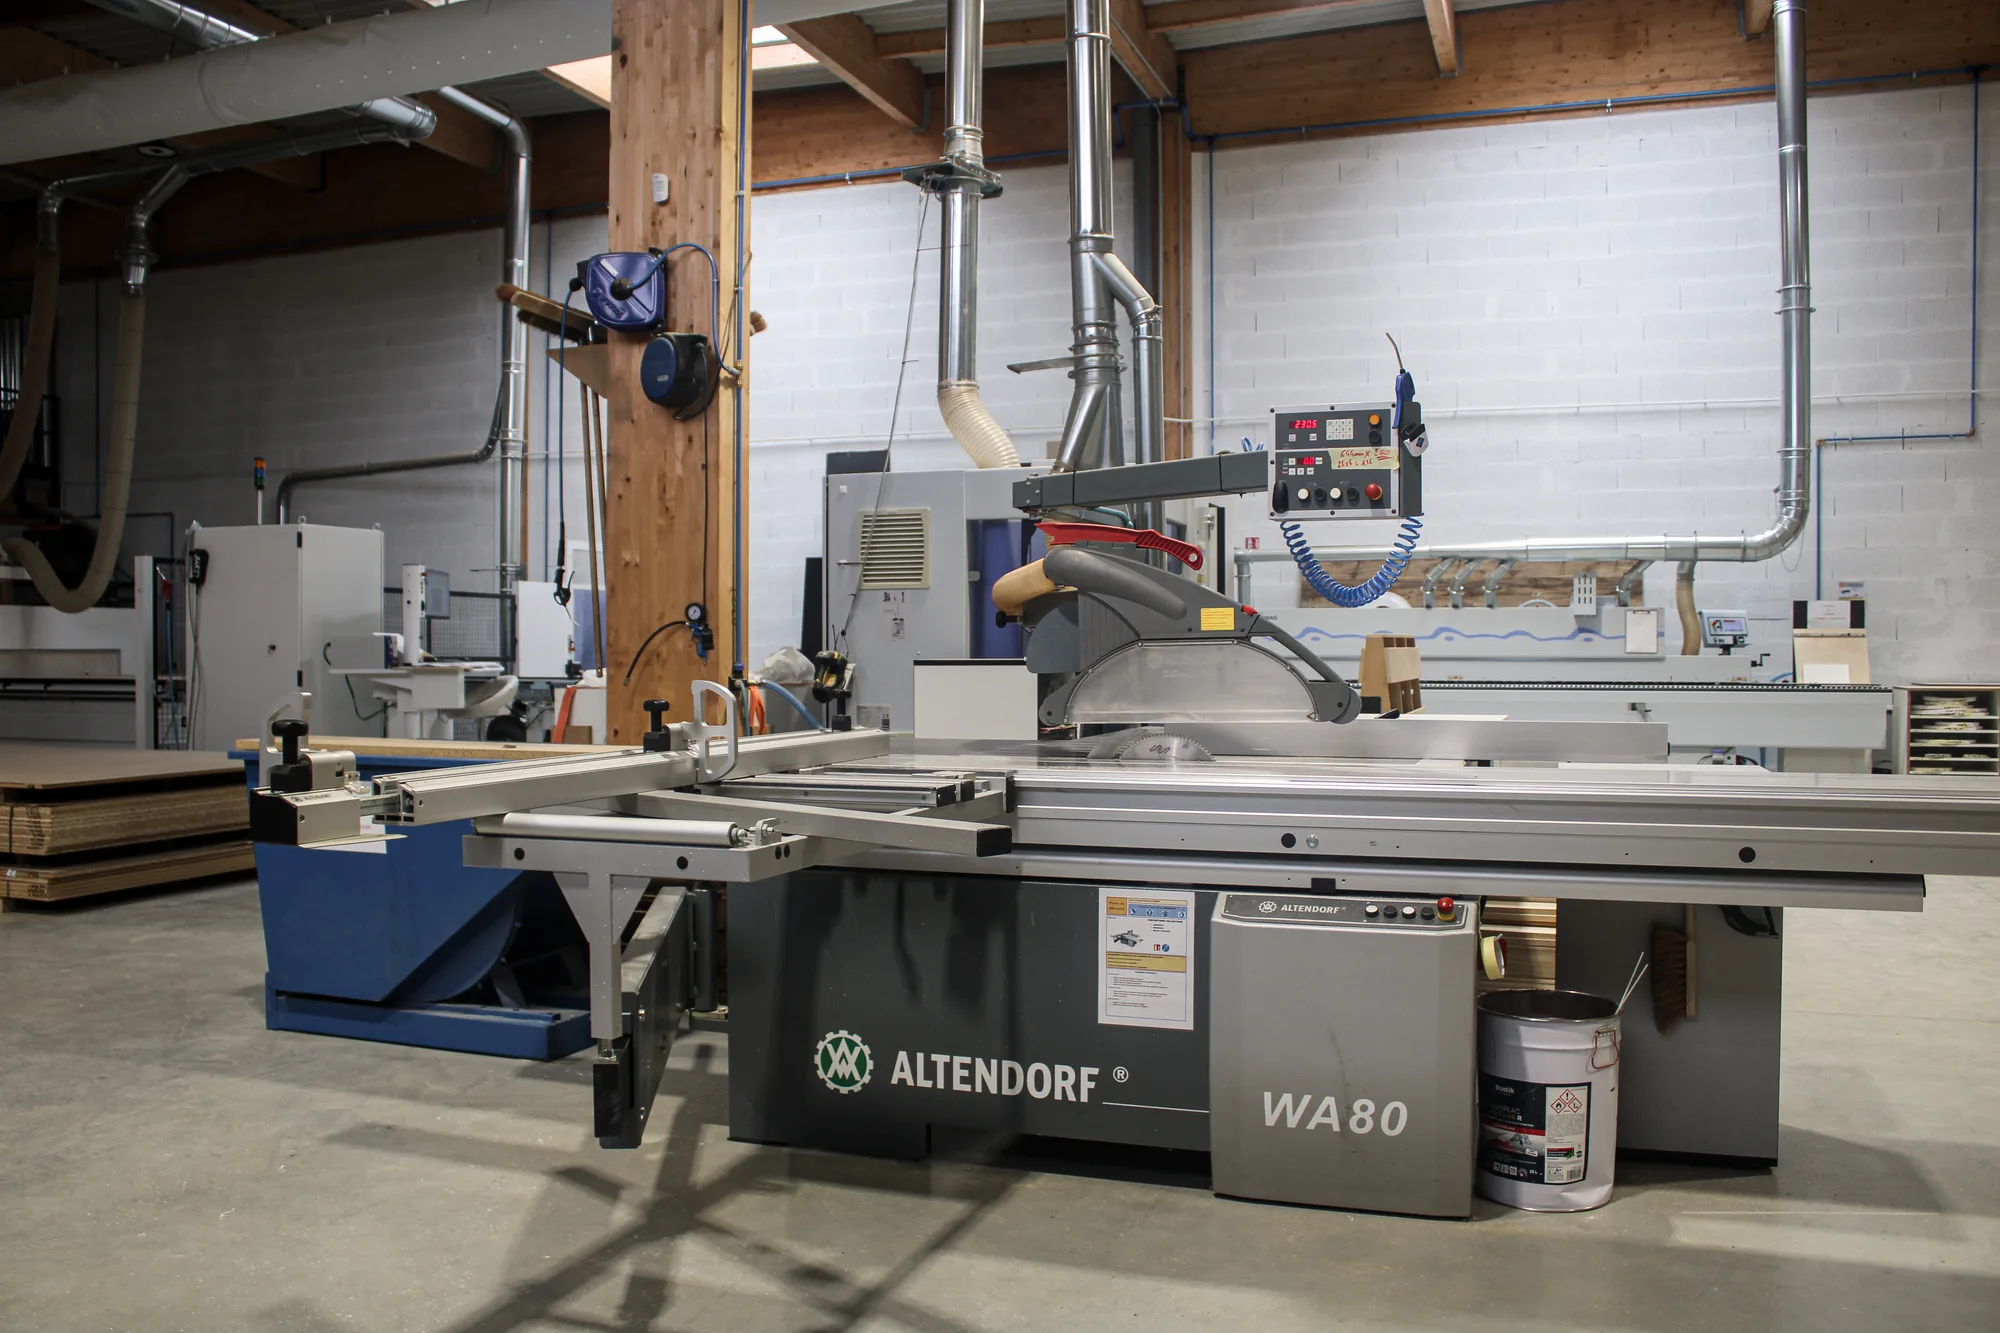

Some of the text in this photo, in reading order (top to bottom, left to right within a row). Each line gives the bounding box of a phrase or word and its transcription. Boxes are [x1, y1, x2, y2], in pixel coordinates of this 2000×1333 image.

[1281, 904, 1340, 914] ALTENDORF
[891, 1051, 1100, 1103] ALTENDORF
[1495, 1084, 1515, 1094] Bostik
